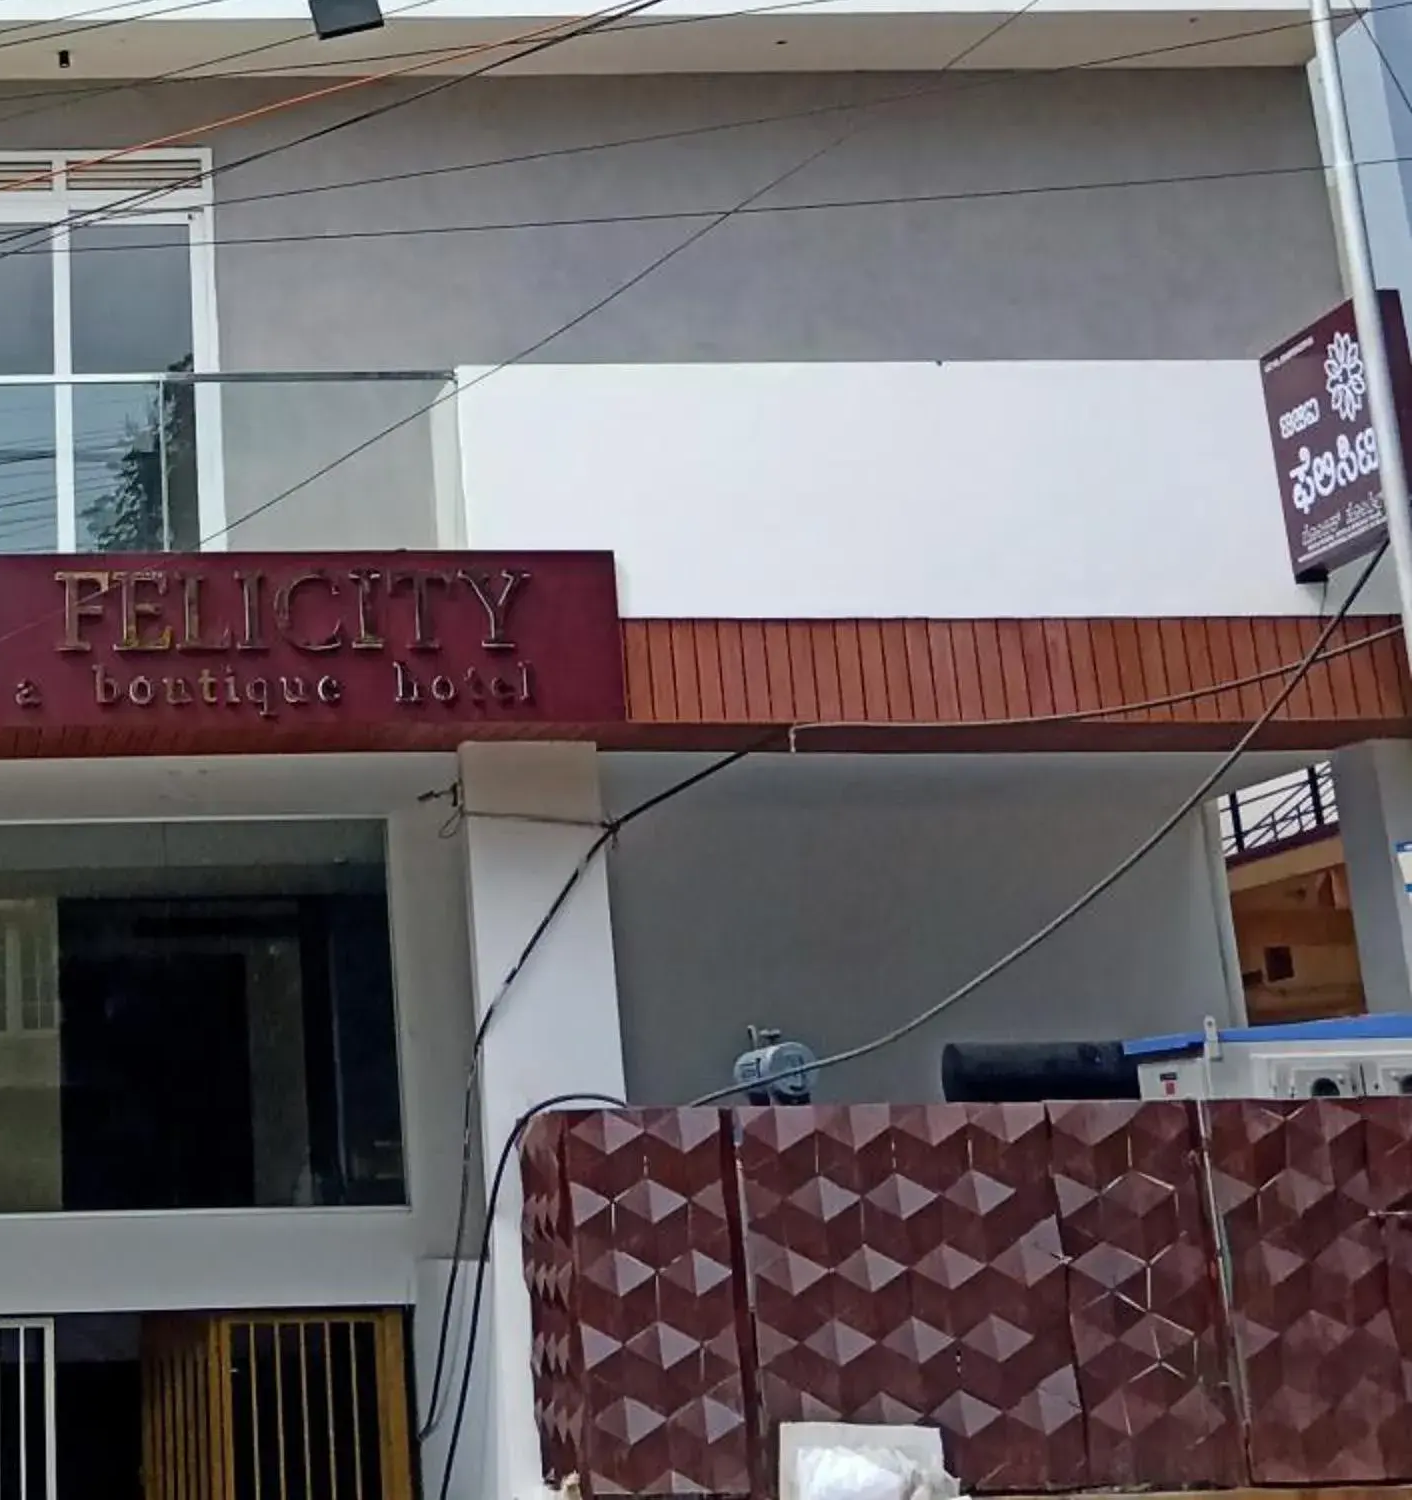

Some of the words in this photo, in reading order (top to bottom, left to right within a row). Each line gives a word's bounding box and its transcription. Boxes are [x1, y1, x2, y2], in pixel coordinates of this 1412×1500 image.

[54, 567, 532, 652] FELICITY
[14, 677, 43, 706] a
[93, 664, 341, 717] boutique
[394, 660, 534, 703] hotel
